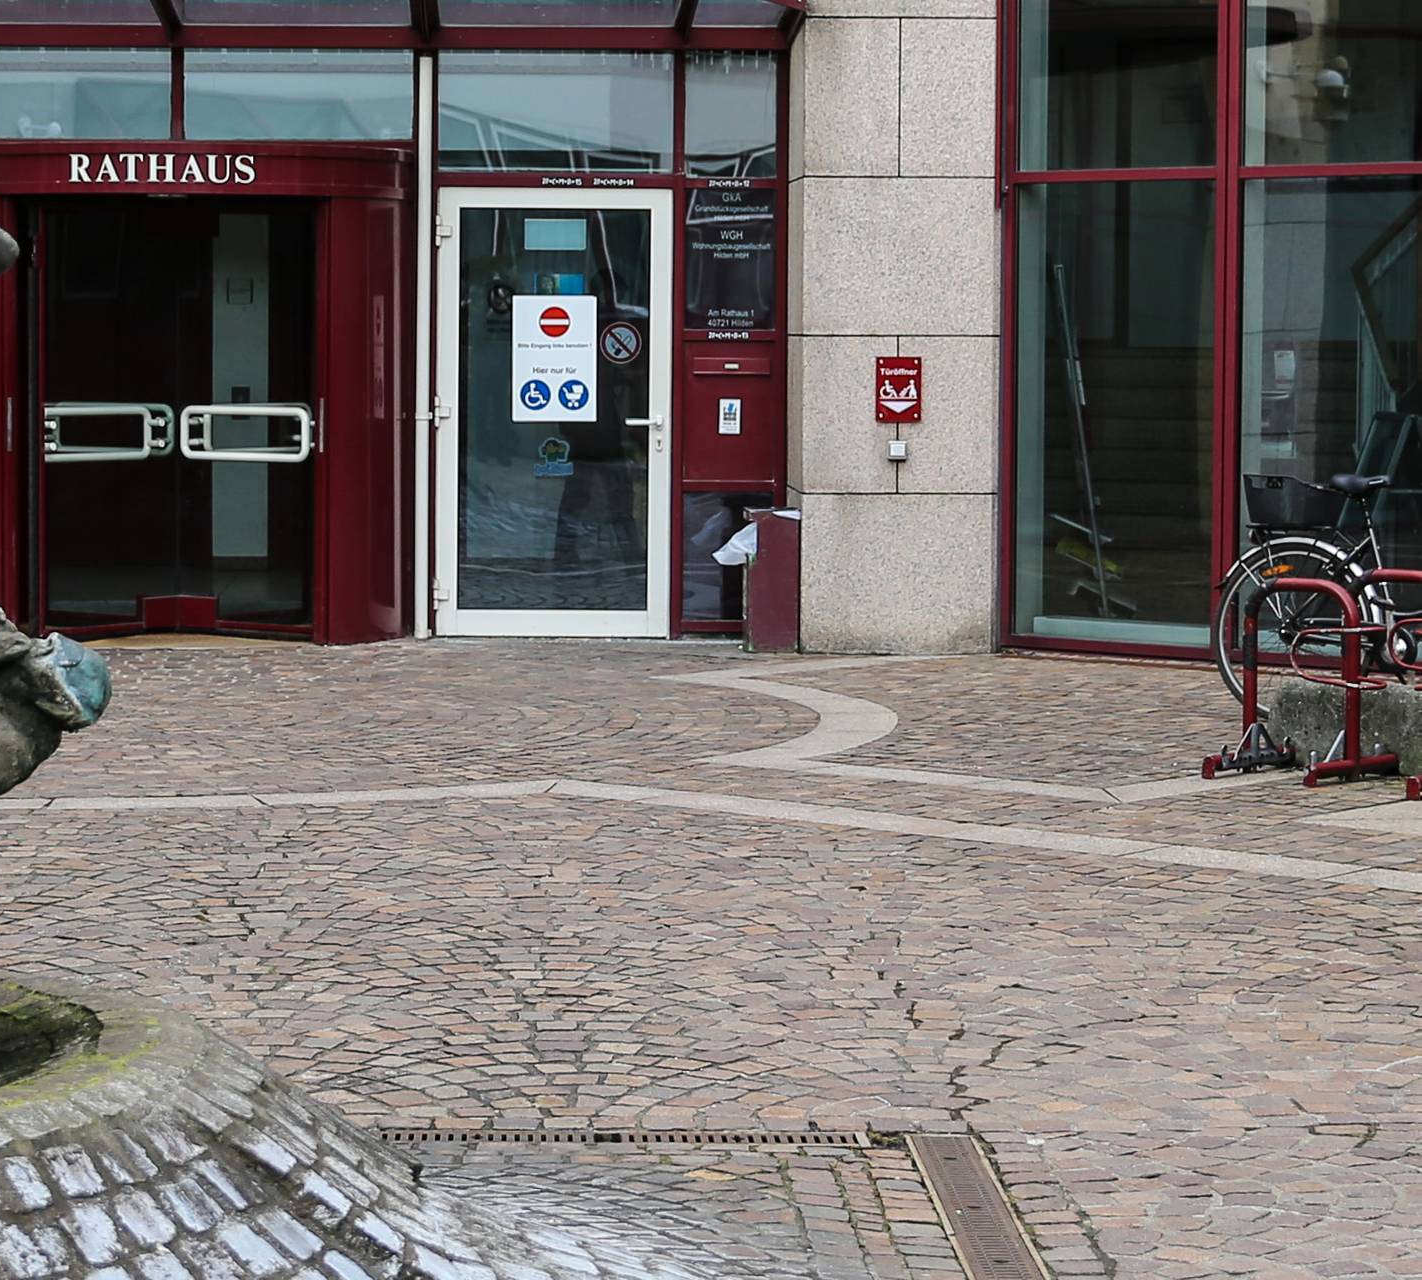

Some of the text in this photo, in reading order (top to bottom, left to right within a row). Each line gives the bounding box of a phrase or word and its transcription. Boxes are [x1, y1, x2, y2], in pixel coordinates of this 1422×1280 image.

[68, 153, 256, 184] RATHAUS
[720, 230, 744, 240] WGH
[707, 309, 720, 317] Am
[720, 309, 749, 317] Rathaus
[707, 319, 754, 327] 40721 Hilden
[880, 367, 918, 376] Türöffner
